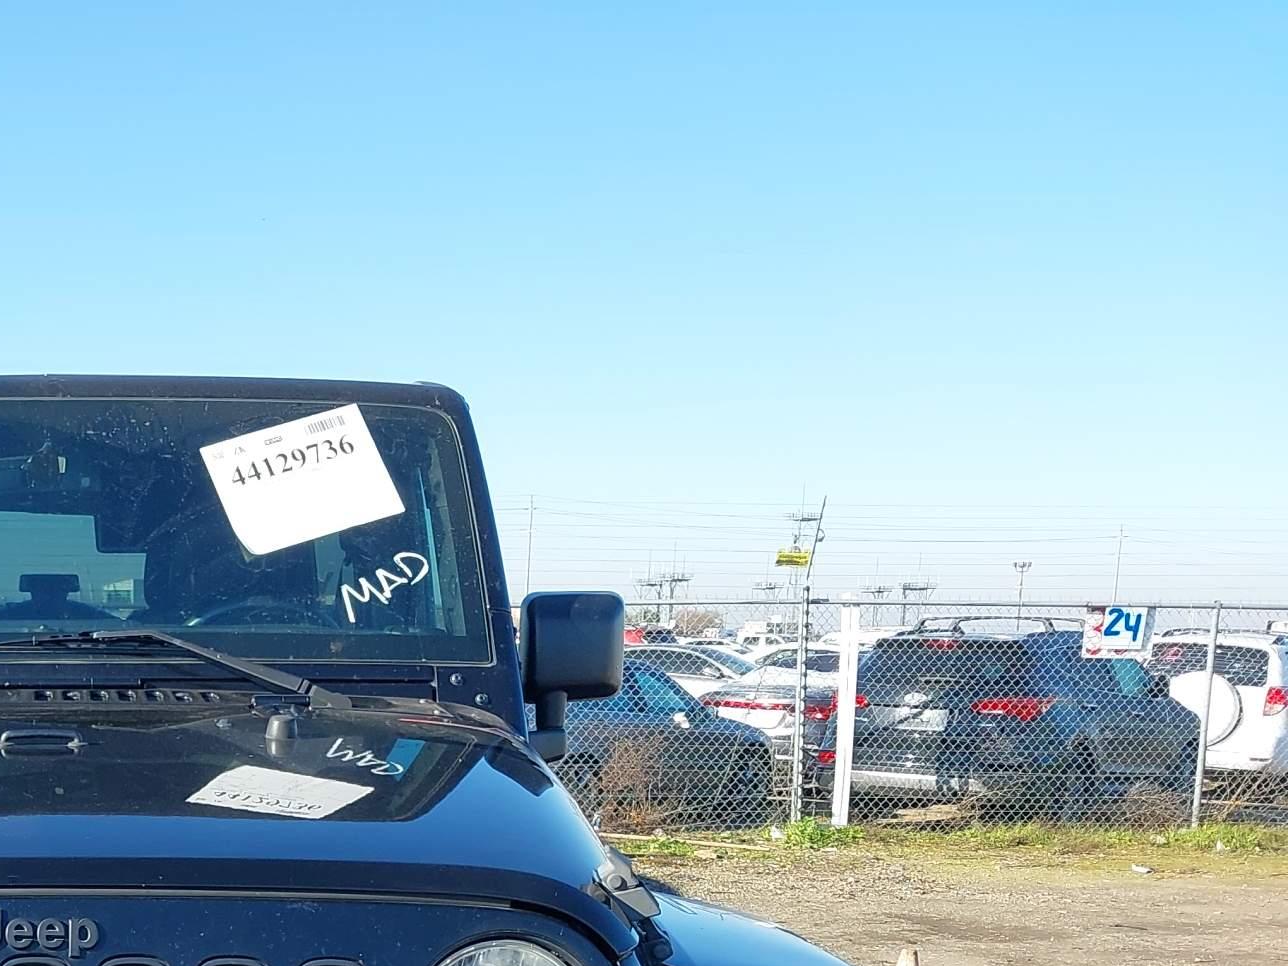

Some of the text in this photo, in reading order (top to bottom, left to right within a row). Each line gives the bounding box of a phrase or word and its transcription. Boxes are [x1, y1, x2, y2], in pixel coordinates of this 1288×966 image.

[232, 434, 354, 485] 44129736
[340, 551, 430, 623] MAD
[1103, 608, 1142, 642] 24
